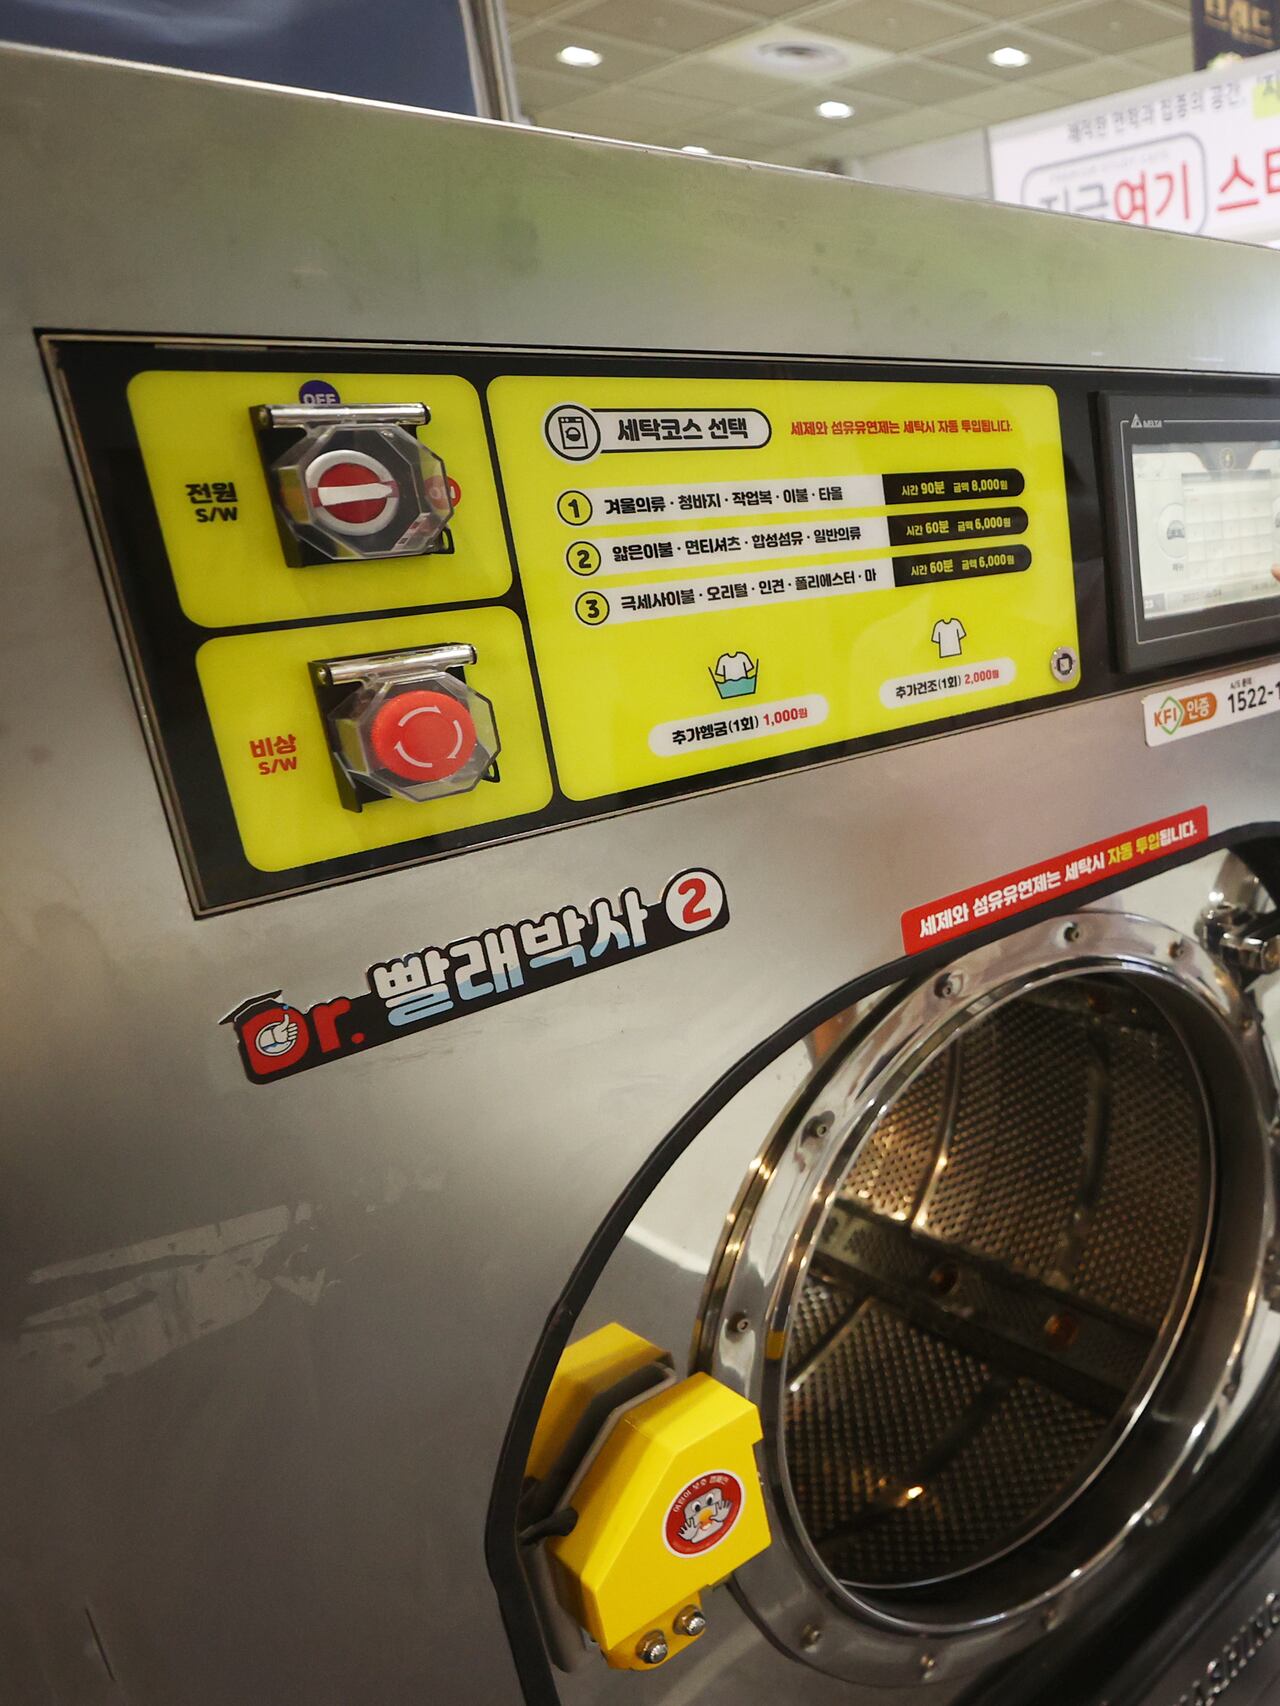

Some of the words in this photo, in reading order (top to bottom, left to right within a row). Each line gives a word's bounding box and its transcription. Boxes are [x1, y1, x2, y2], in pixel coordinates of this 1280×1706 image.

[617, 418, 703, 442] 세탁코스
[708, 417, 749, 440] 선택
[791, 420, 828, 436] 세제와
[831, 420, 900, 435] 섬유유연제는
[903, 420, 936, 434] 세탁시
[938, 419, 960, 434] 자동
[961, 419, 1013, 434] 투입됩니다.
[185, 481, 238, 504] 전원
[902, 487, 919, 497] 시간
[921, 481, 945, 496] 90분
[953, 482, 970, 494] 금액
[971, 478, 1009, 493] 8,000원
[603, 496, 666, 515] 겨울의류
[678, 493, 721, 511] 청바지
[732, 490, 773, 506] 작업복
[783, 488, 809, 503] 이불
[194, 506, 238, 523] S/W
[906, 527, 923, 537] 시간
[925, 520, 950, 535] 60분
[957, 521, 974, 533] 금액
[974, 517, 1012, 531] 6,000원
[612, 541, 674, 562] 얇은이불
[684, 536, 742, 556] 면티셔츠
[751, 531, 804, 549] 합성섬유
[813, 526, 862, 544] 일반의류
[910, 567, 928, 577] 시간
[930, 560, 954, 574] 60분
[961, 560, 978, 572] 금액
[978, 555, 1015, 570] 6,000원
[620, 588, 696, 611] 극세사이불
[706, 582, 748, 602] 오리털
[758, 578, 785, 595] 인견
[794, 570, 856, 592] 폴리에스터
[865, 568, 877, 584] 마
[895, 675, 962, 700] 추가건조(1회)
[964, 669, 1000, 686] 2,000원
[1153, 706, 1178, 728] KFI
[1186, 696, 1210, 721] 인증
[671, 715, 759, 746] 추가헹굼(1회)
[763, 706, 809, 727] 1,000원
[250, 733, 297, 758] 비상
[258, 756, 297, 775] S/W
[919, 904, 970, 939] 세제와
[972, 870, 1061, 919] 섬유유연제는
[1064, 852, 1106, 884] 세탁시
[1107, 842, 1133, 866] 자동
[1135, 820, 1198, 855] 투입됩니다.
[372, 888, 651, 1027] 빨래박사
[677, 876, 713, 926] 2
